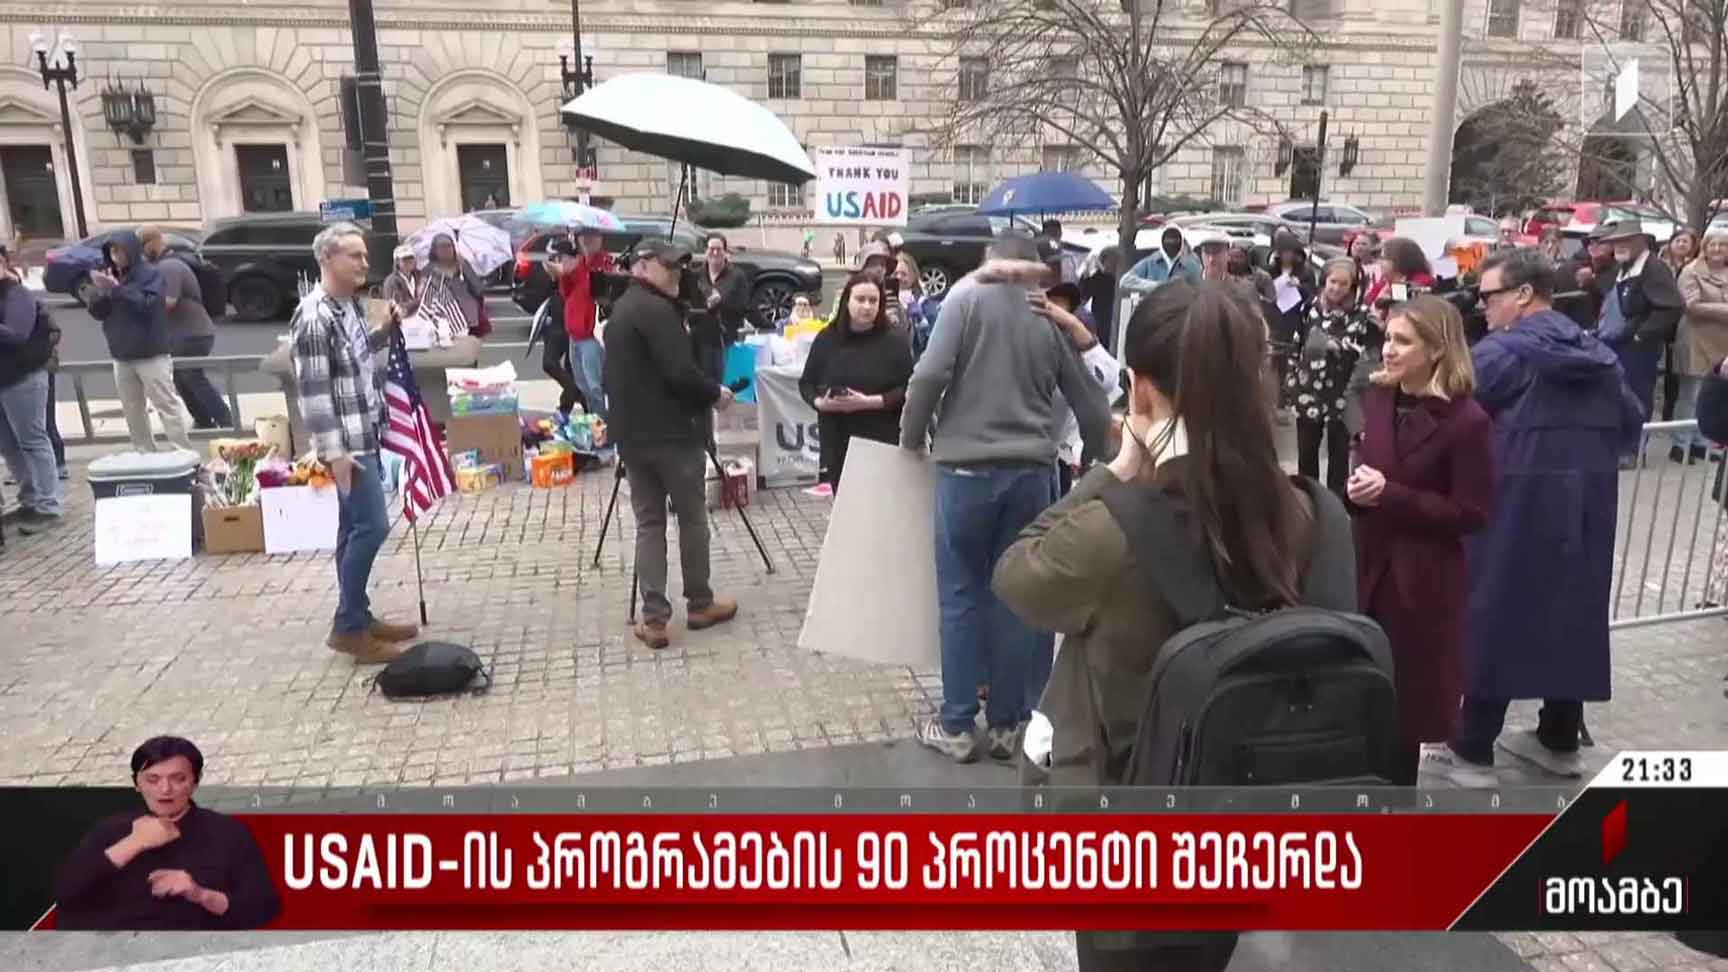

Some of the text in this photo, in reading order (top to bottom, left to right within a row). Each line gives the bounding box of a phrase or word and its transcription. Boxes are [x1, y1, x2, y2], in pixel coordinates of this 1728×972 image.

[828, 167, 899, 181] THANK YOU
[826, 191, 902, 219] USAID
